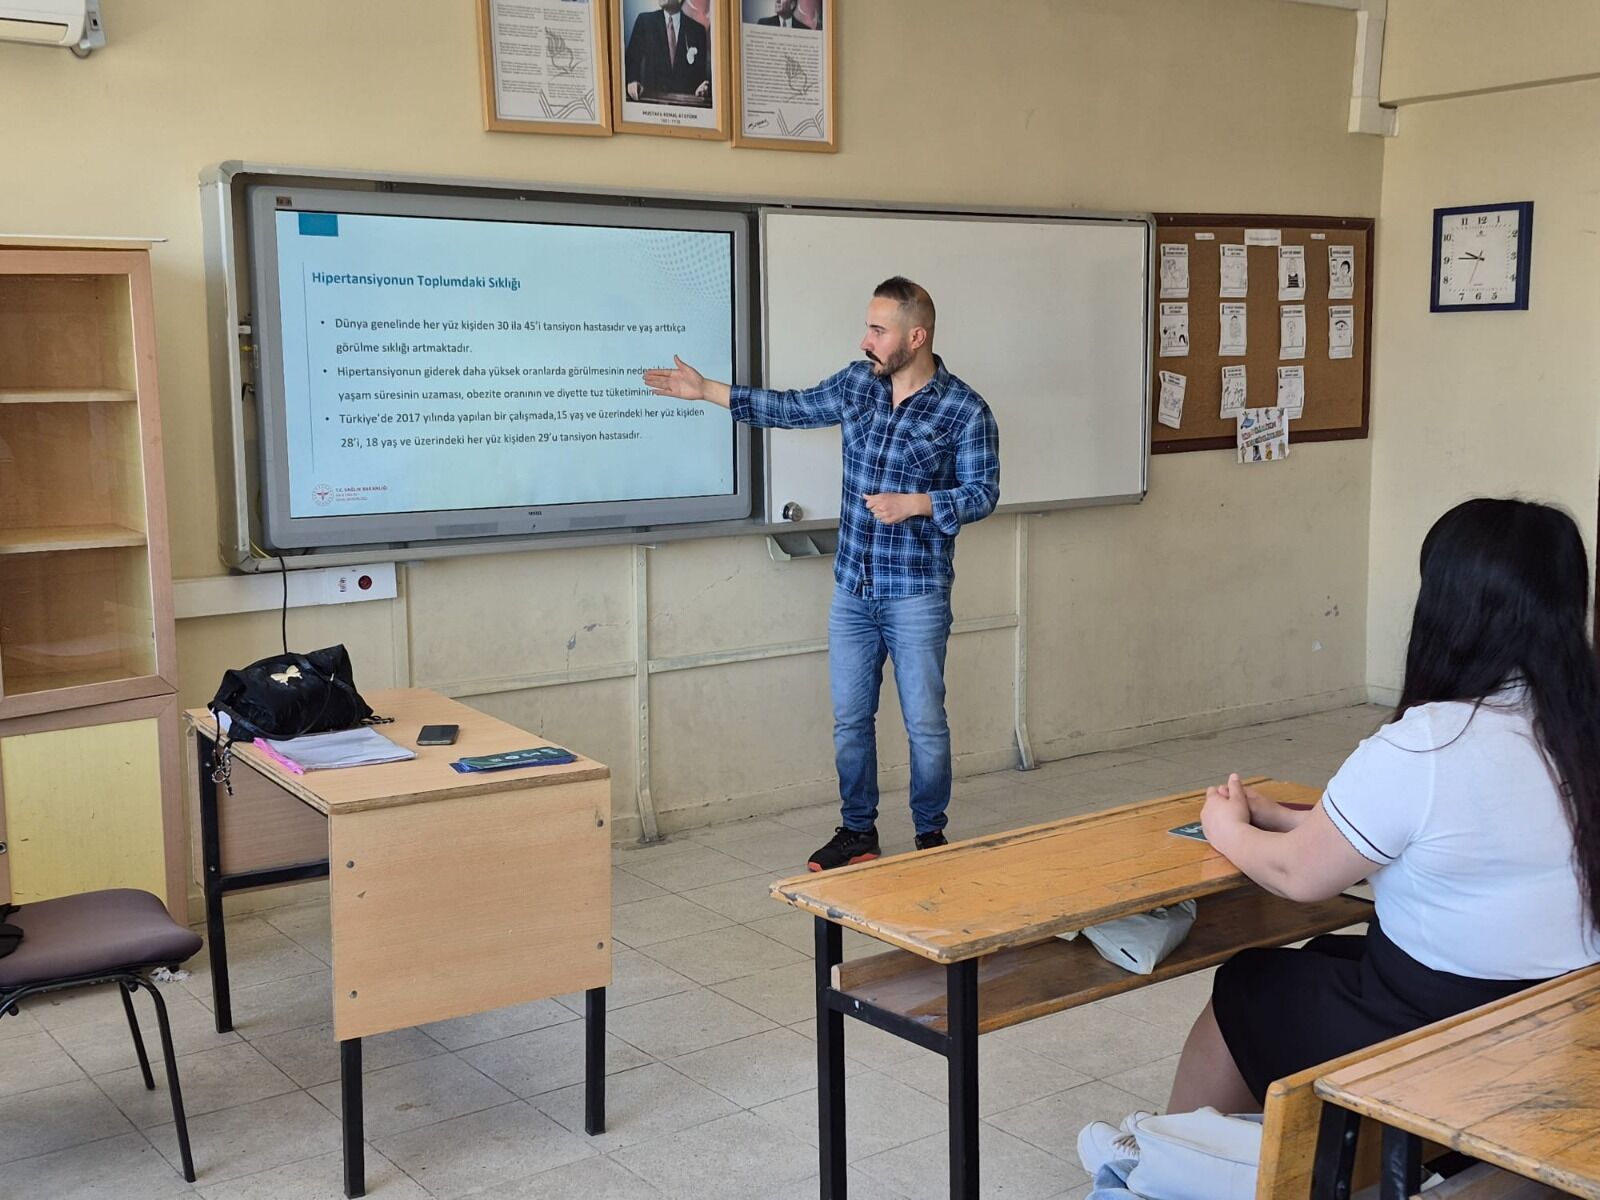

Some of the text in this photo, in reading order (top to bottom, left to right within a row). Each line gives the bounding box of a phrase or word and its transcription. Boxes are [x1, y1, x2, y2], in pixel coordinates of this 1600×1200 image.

[1461, 217, 1469, 226] 11
[1478, 216, 1488, 225] 12
[1443, 233, 1452, 242] 10
[1511, 230, 1519, 238] 2
[1443, 256, 1450, 265] 9
[1510, 252, 1517, 260] 3
[312, 272, 520, 291] Hipertansiyonun Toplumdaki Sıklığı
[1443, 276, 1449, 285] 8
[1459, 292, 1465, 301] 7
[1475, 292, 1482, 300] 6
[1491, 292, 1498, 300] 5
[335, 318, 368, 331] Dünya
[371, 318, 420, 331] genelinde
[423, 320, 440, 330] her
[442, 321, 459, 333] yüz
[461, 320, 495, 332] kişiden
[497, 321, 510, 331] 30
[511, 321, 521, 331] ila
[543, 321, 582, 333] tansiyon
[584, 321, 625, 332] hastasıdır
[627, 324, 638, 332] ve
[639, 324, 653, 334] yaş
[654, 322, 685, 334] arttıkça
[336, 342, 472, 355] görülme sıklığı artmaktadır.
[337, 366, 422, 379] Hipertansiyonun
[424, 365, 460, 378] giderek
[463, 365, 486, 376] daha
[489, 365, 521, 378] yüksek
[522, 366, 566, 377] oranlarda
[569, 365, 624, 377] görülmesinin
[338, 392, 371, 403] yaşam
[374, 389, 419, 400] süresinin
[422, 391, 465, 402] uzaması,
[467, 389, 502, 400] obezite
[504, 390, 541, 399] oranının
[543, 391, 555, 399] ve
[557, 388, 588, 401] diyette
[590, 389, 604, 399] tuz
[396, 411, 420, 423] 2017
[424, 411, 455, 424] yılında
[457, 411, 491, 424] yapılan
[494, 411, 507, 421] bir
[569, 410, 584, 421] yaş
[586, 411, 597, 419] ve
[598, 408, 643, 419] üzerindeki
[645, 408, 659, 418] her
[661, 408, 675, 420] yüz
[677, 407, 705, 419] kişiden
[366, 437, 379, 447] 18
[381, 438, 398, 449] yaş
[400, 438, 412, 446] ve
[414, 435, 464, 446] üzerindeki
[467, 434, 484, 445] her
[485, 435, 502, 447] yüz
[504, 433, 536, 445] kişiden
[560, 431, 597, 443] tansiyon
[599, 430, 642, 441] hastasıdır.
